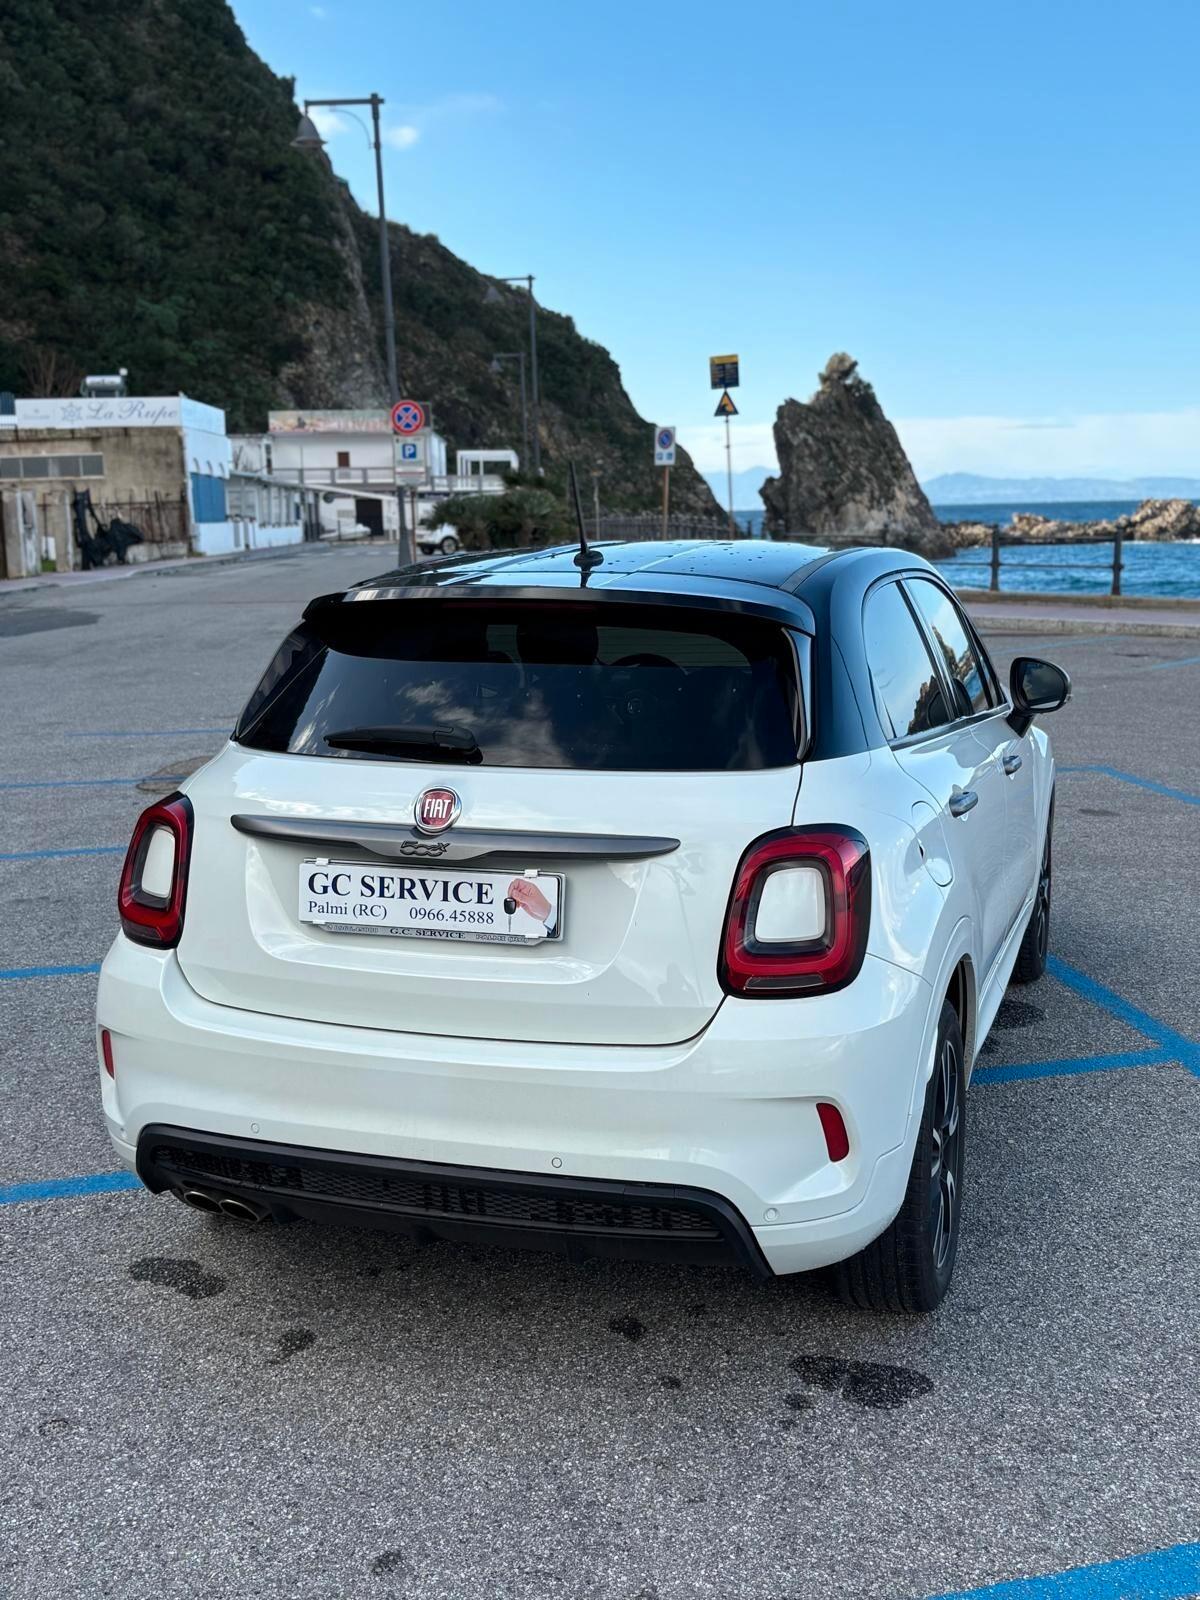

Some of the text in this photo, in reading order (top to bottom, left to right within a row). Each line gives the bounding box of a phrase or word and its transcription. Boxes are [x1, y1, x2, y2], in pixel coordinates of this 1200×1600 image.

[86, 400, 178, 425] La Rupe
[404, 445, 415, 458] P
[423, 798, 452, 819] FIAT
[307, 872, 494, 905] GC SERVICE
[308, 901, 495, 925] Palmi (RC) 0966.45888
[389, 928, 413, 936] G.C.
[415, 928, 466, 939] SERVICE
